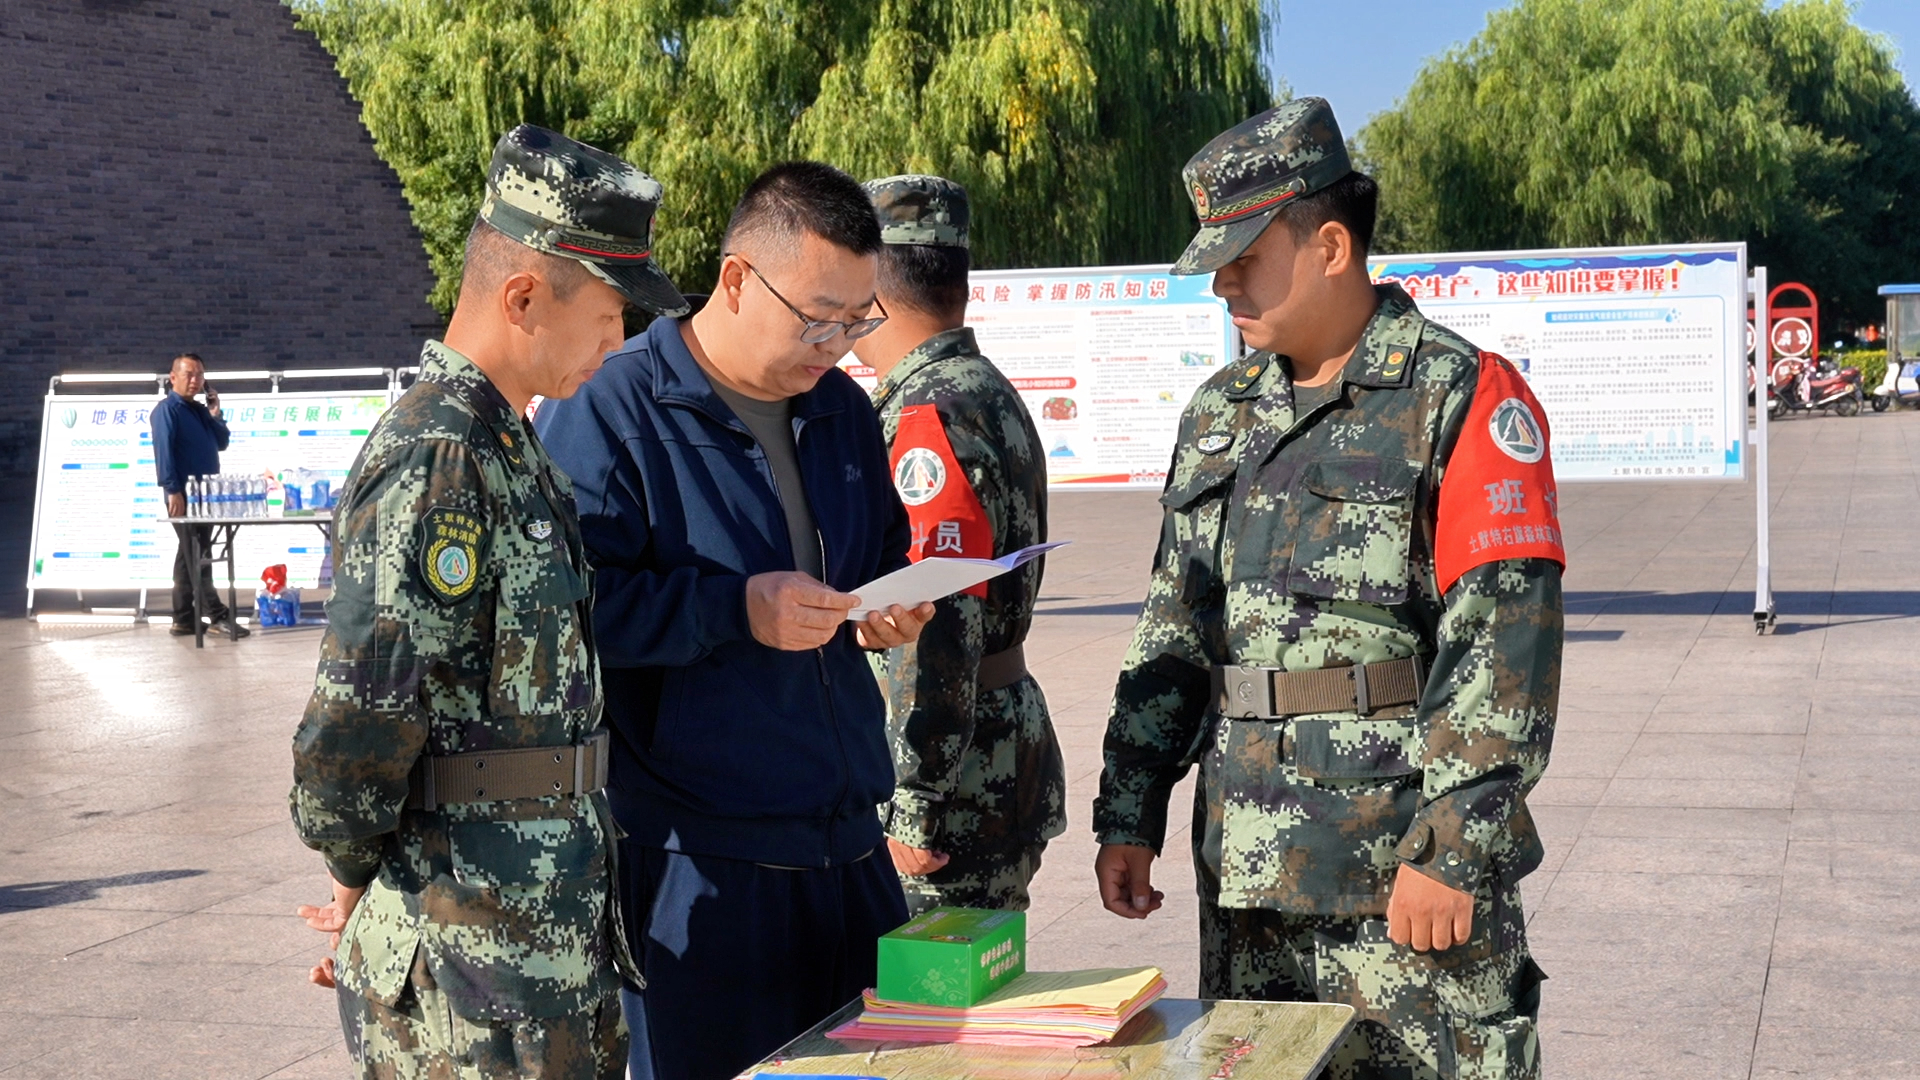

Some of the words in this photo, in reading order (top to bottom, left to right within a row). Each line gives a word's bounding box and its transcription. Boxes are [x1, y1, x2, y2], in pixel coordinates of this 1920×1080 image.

[971, 285, 1010, 302] 风险
[1027, 280, 1168, 302] 掌握防汛知识
[432, 513, 482, 535] 土默特右旗
[436, 524, 478, 545] 森林消防
